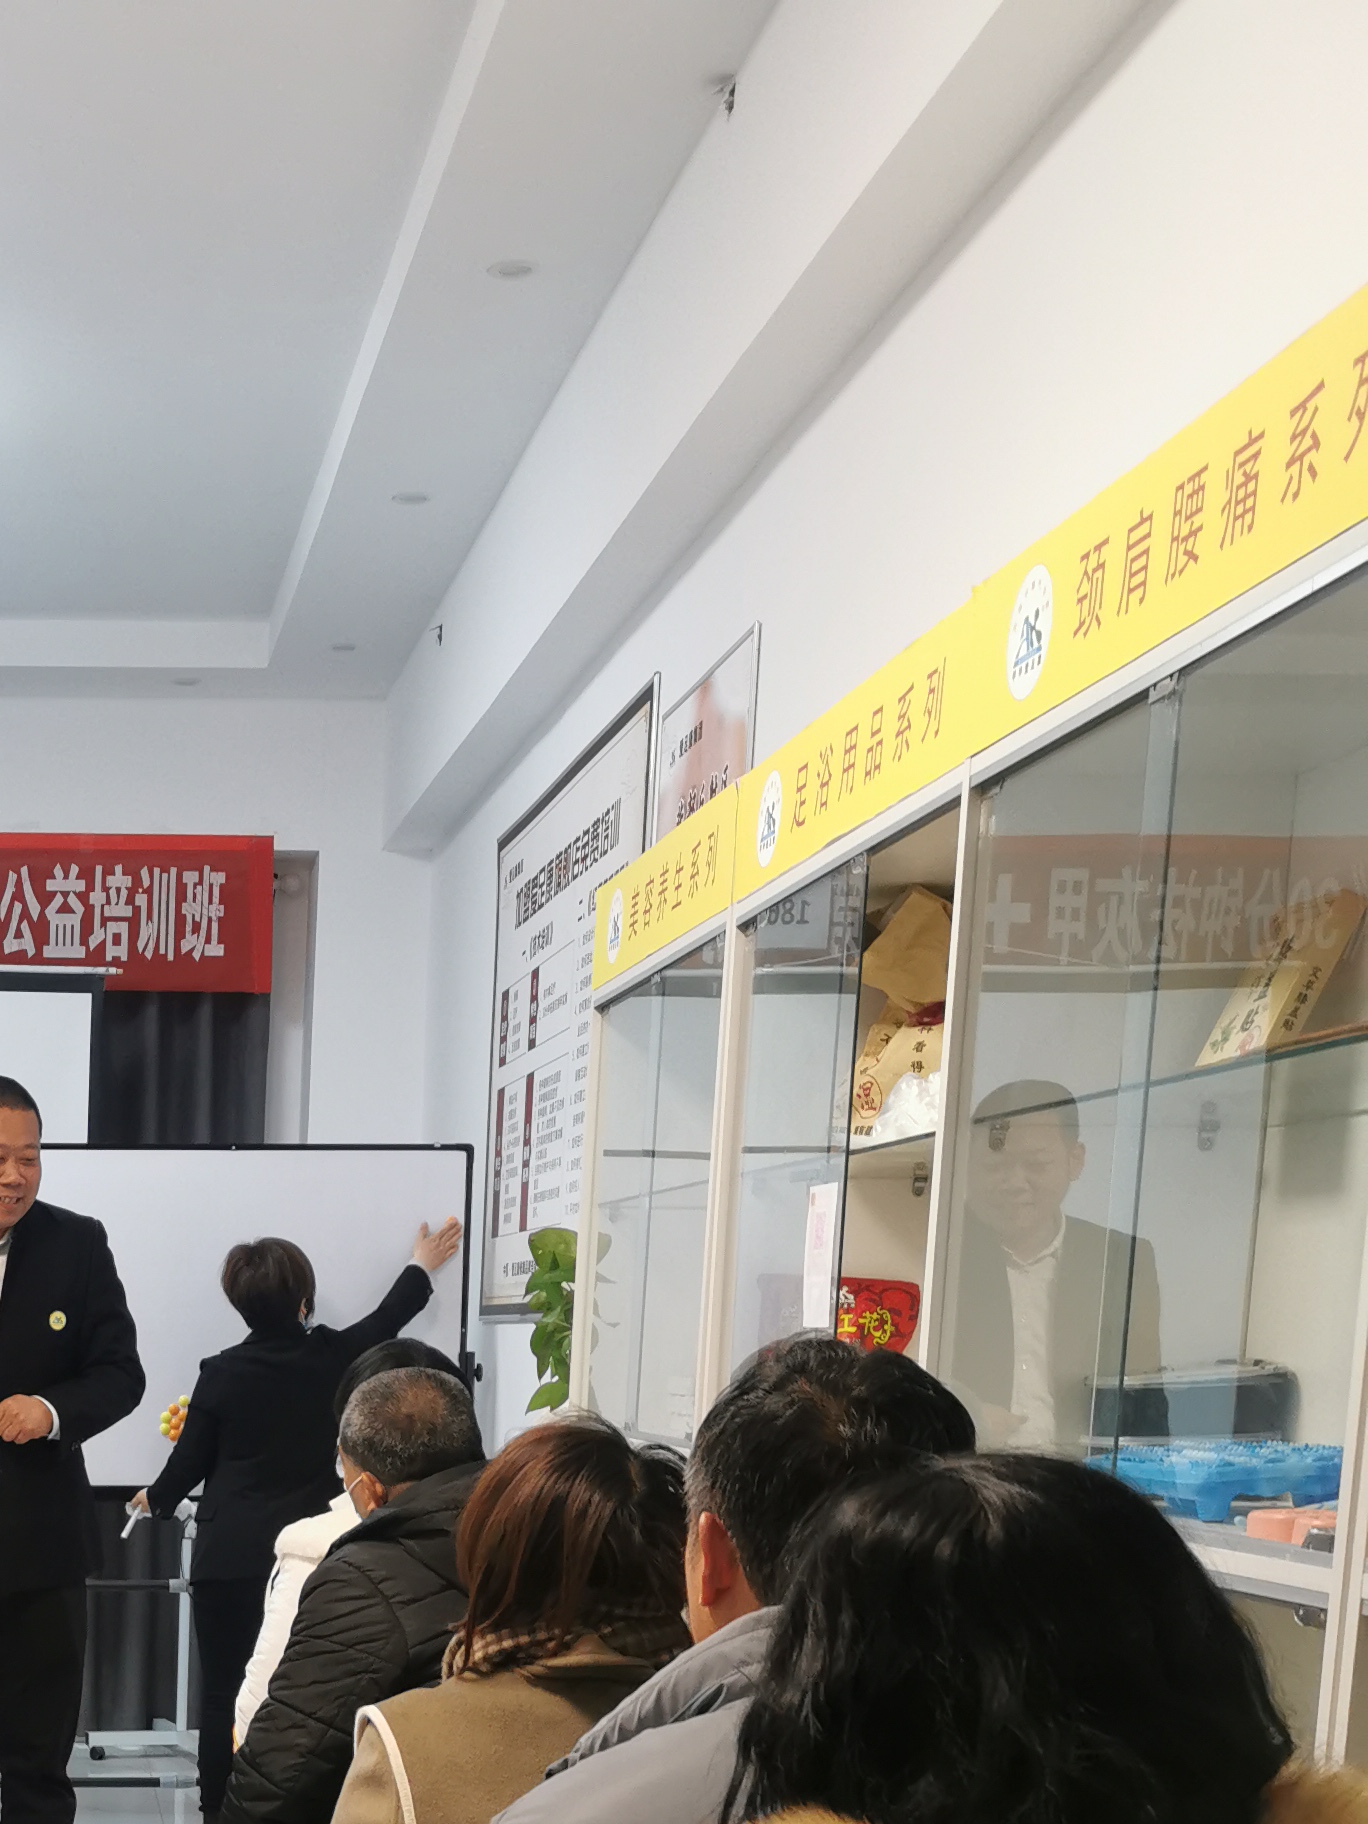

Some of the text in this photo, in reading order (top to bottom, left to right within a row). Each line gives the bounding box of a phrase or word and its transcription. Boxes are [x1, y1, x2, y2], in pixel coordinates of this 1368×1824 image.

[790, 656, 946, 833] 足浴用品系列
[628, 824, 719, 941] 美容养生系列
